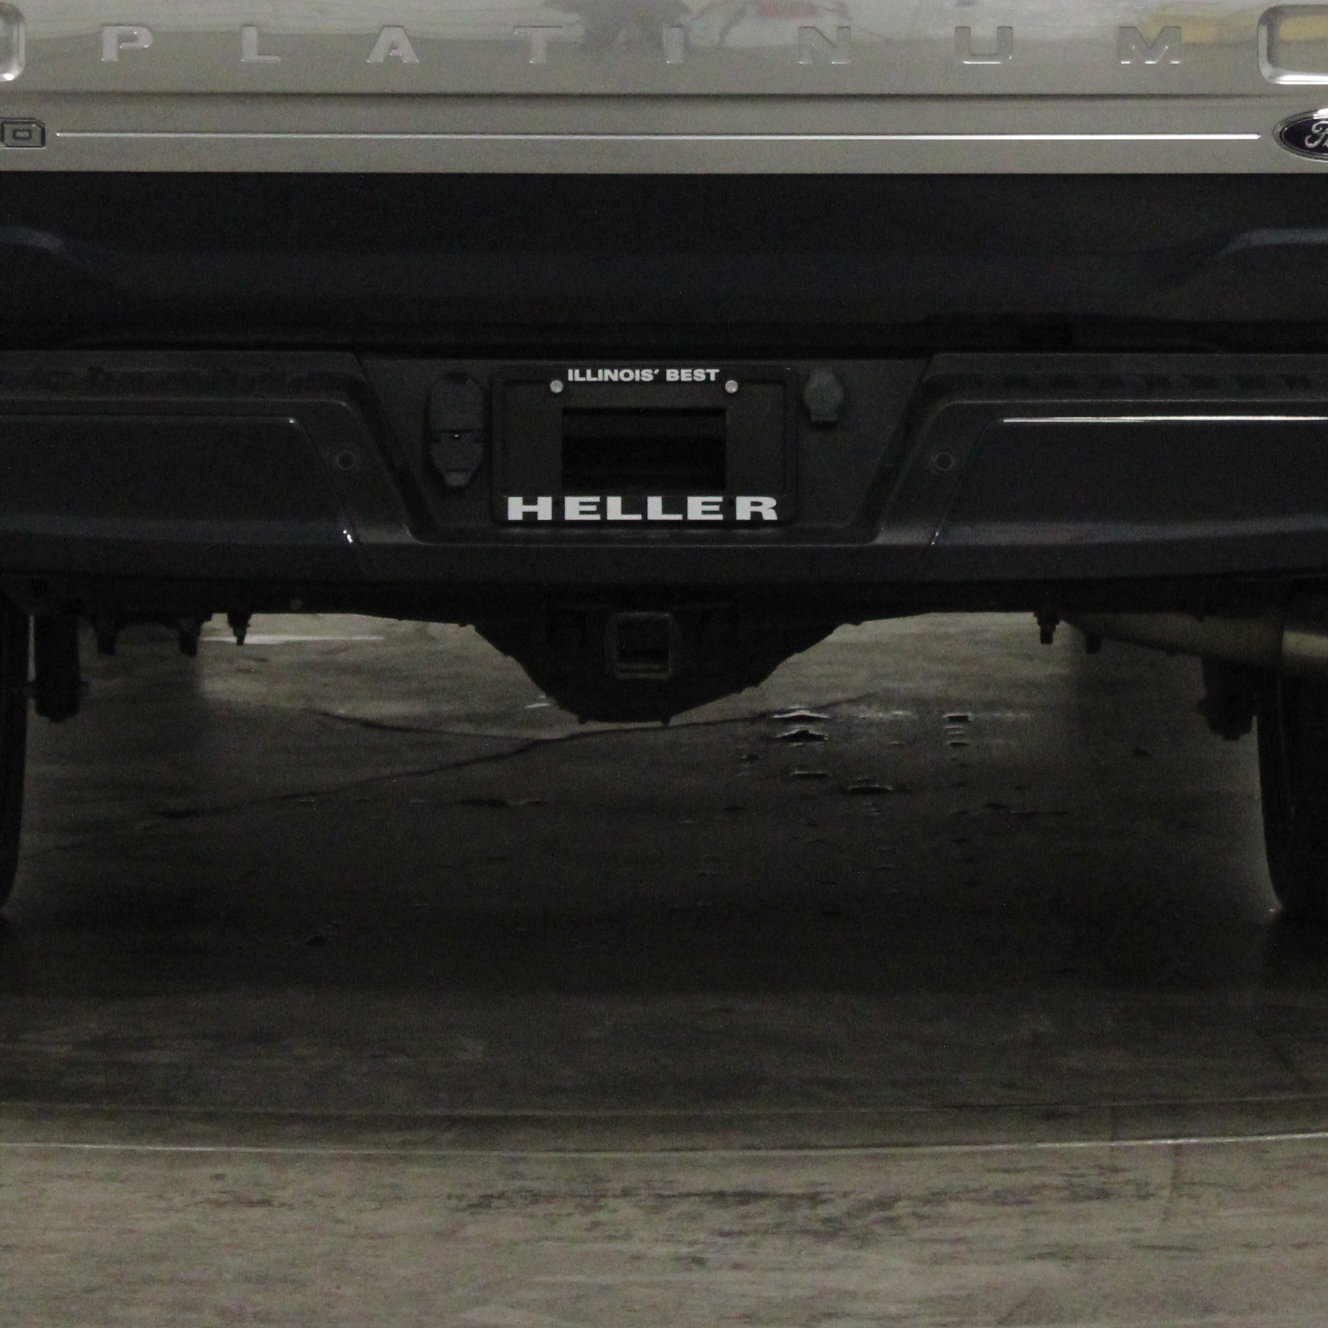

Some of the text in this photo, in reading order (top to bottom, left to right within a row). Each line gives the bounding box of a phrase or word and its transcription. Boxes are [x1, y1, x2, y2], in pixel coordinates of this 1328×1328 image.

[100, 25, 1183, 64] PLATINUM
[665, 368, 720, 382] BEST
[507, 496, 778, 521] HELLER
